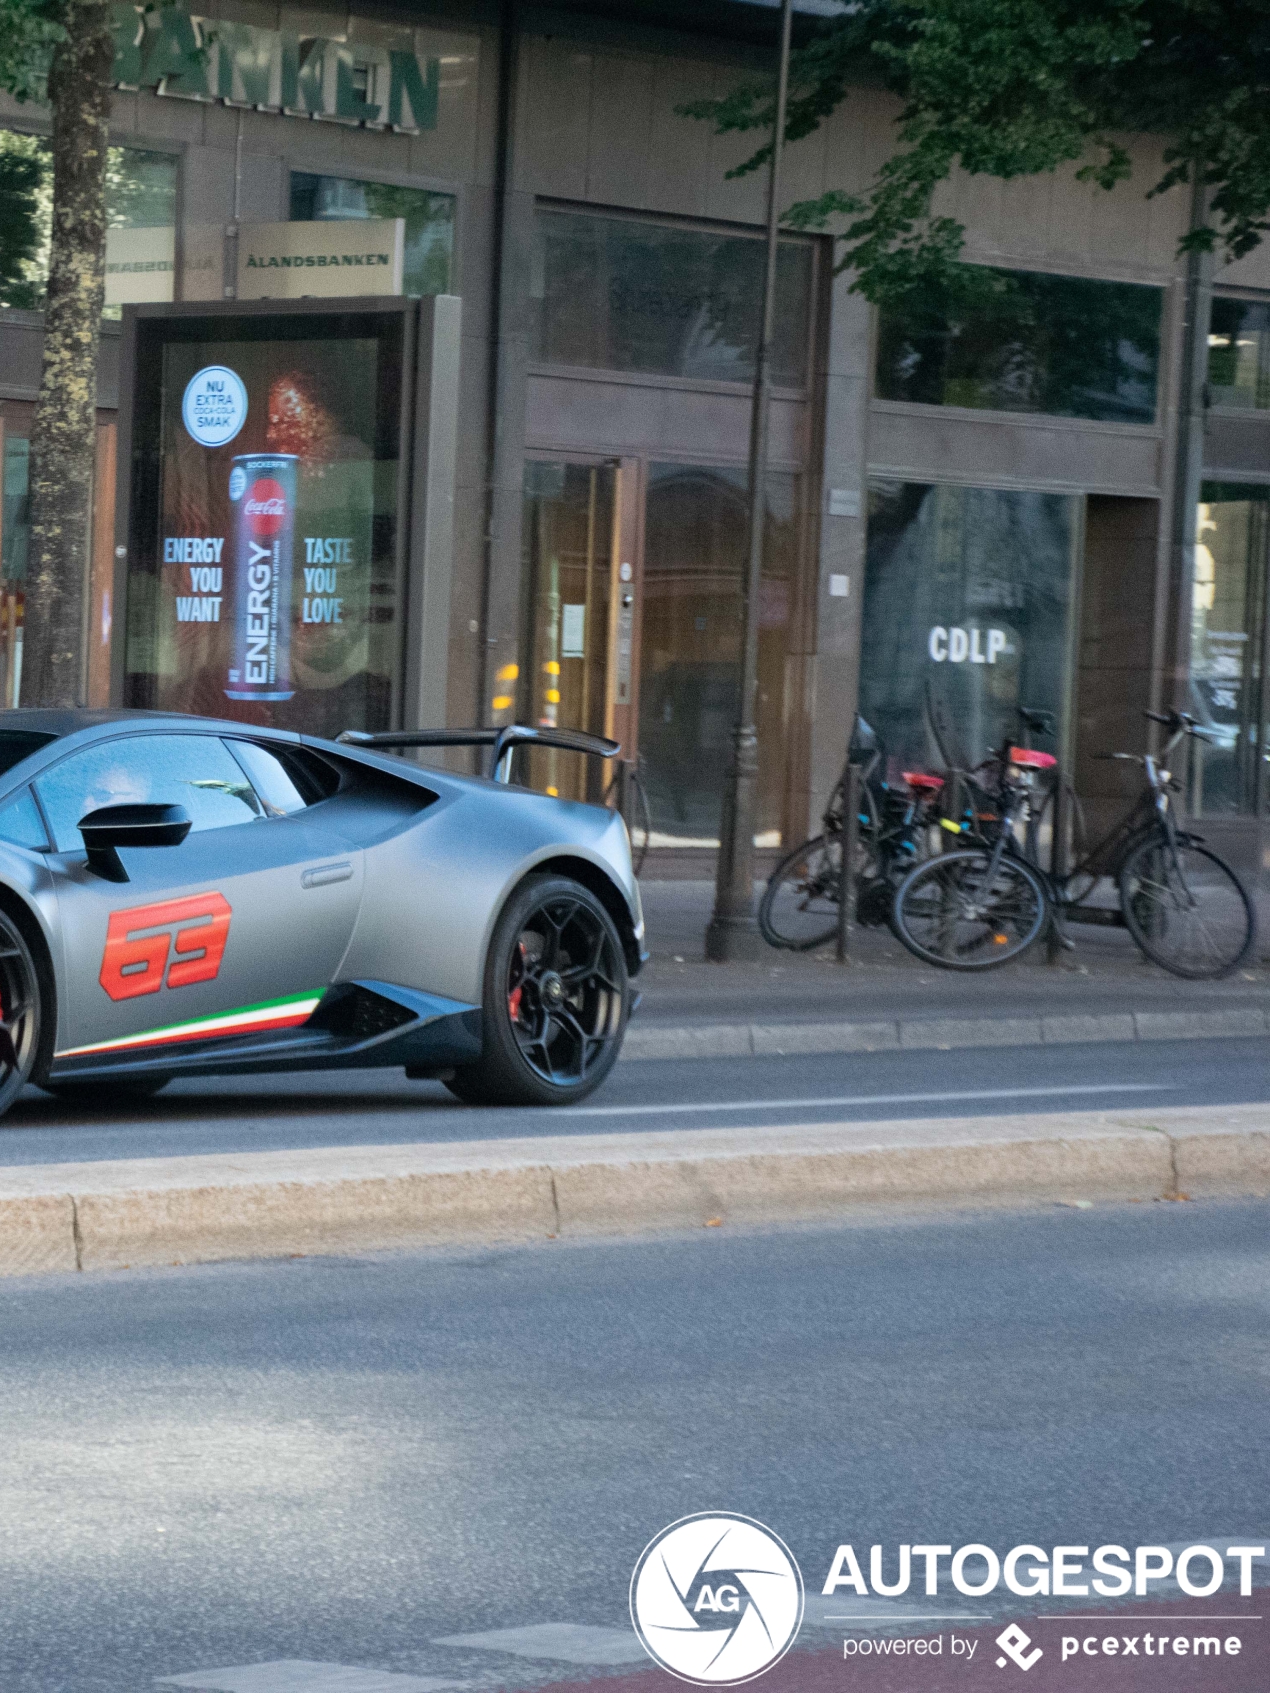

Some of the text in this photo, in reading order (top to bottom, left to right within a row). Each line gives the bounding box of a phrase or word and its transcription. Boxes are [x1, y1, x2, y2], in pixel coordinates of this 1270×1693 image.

[246, 252, 389, 268] ÅLANDSBANKEN
[206, 381, 225, 392] NU
[196, 395, 233, 406] EXTRA
[197, 417, 230, 427] SMAK
[164, 537, 224, 562] ENERGY
[304, 538, 354, 563] TASTE
[190, 567, 223, 592] YOU
[303, 568, 336, 593] YOU
[176, 597, 223, 622] WANT
[245, 541, 271, 684] ENERGY
[303, 598, 343, 623] LOVE
[930, 626, 1006, 664] CDLP
[99, 890, 232, 1002] 63
